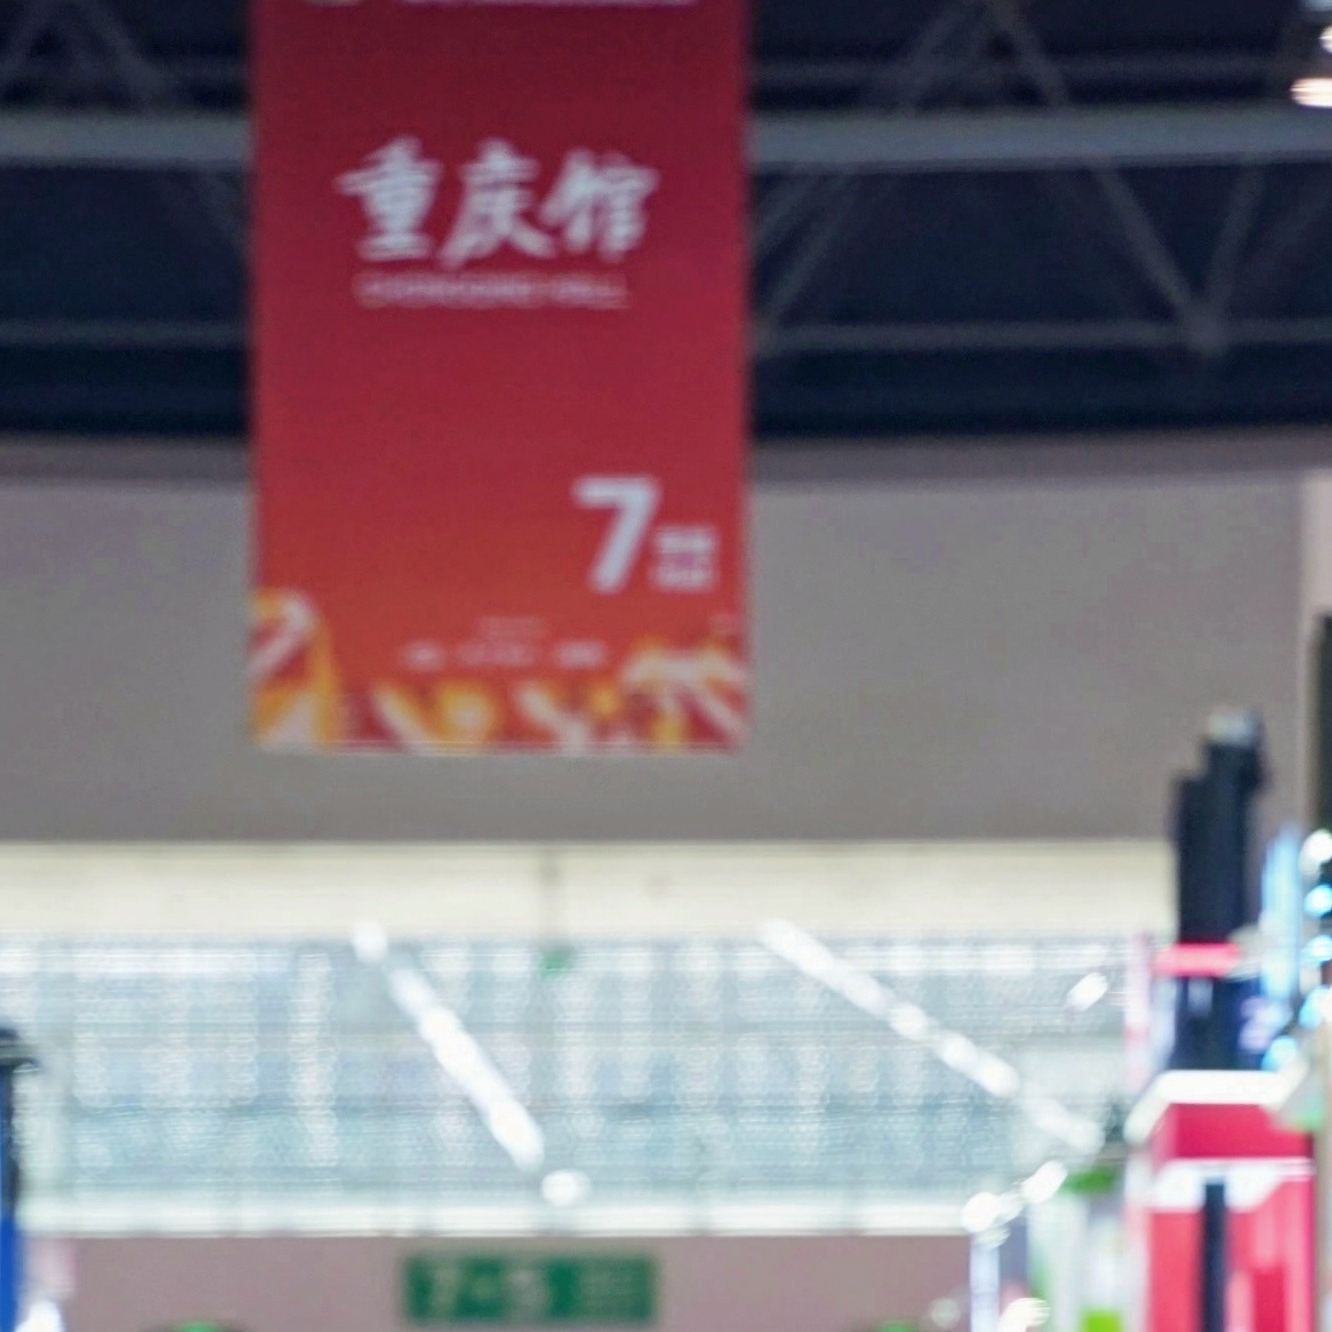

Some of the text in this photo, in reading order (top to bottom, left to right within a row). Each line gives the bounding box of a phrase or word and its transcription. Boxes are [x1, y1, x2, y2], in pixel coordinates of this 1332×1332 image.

[336, 137, 660, 268] 重庆馆
[574, 475, 659, 593] 7
